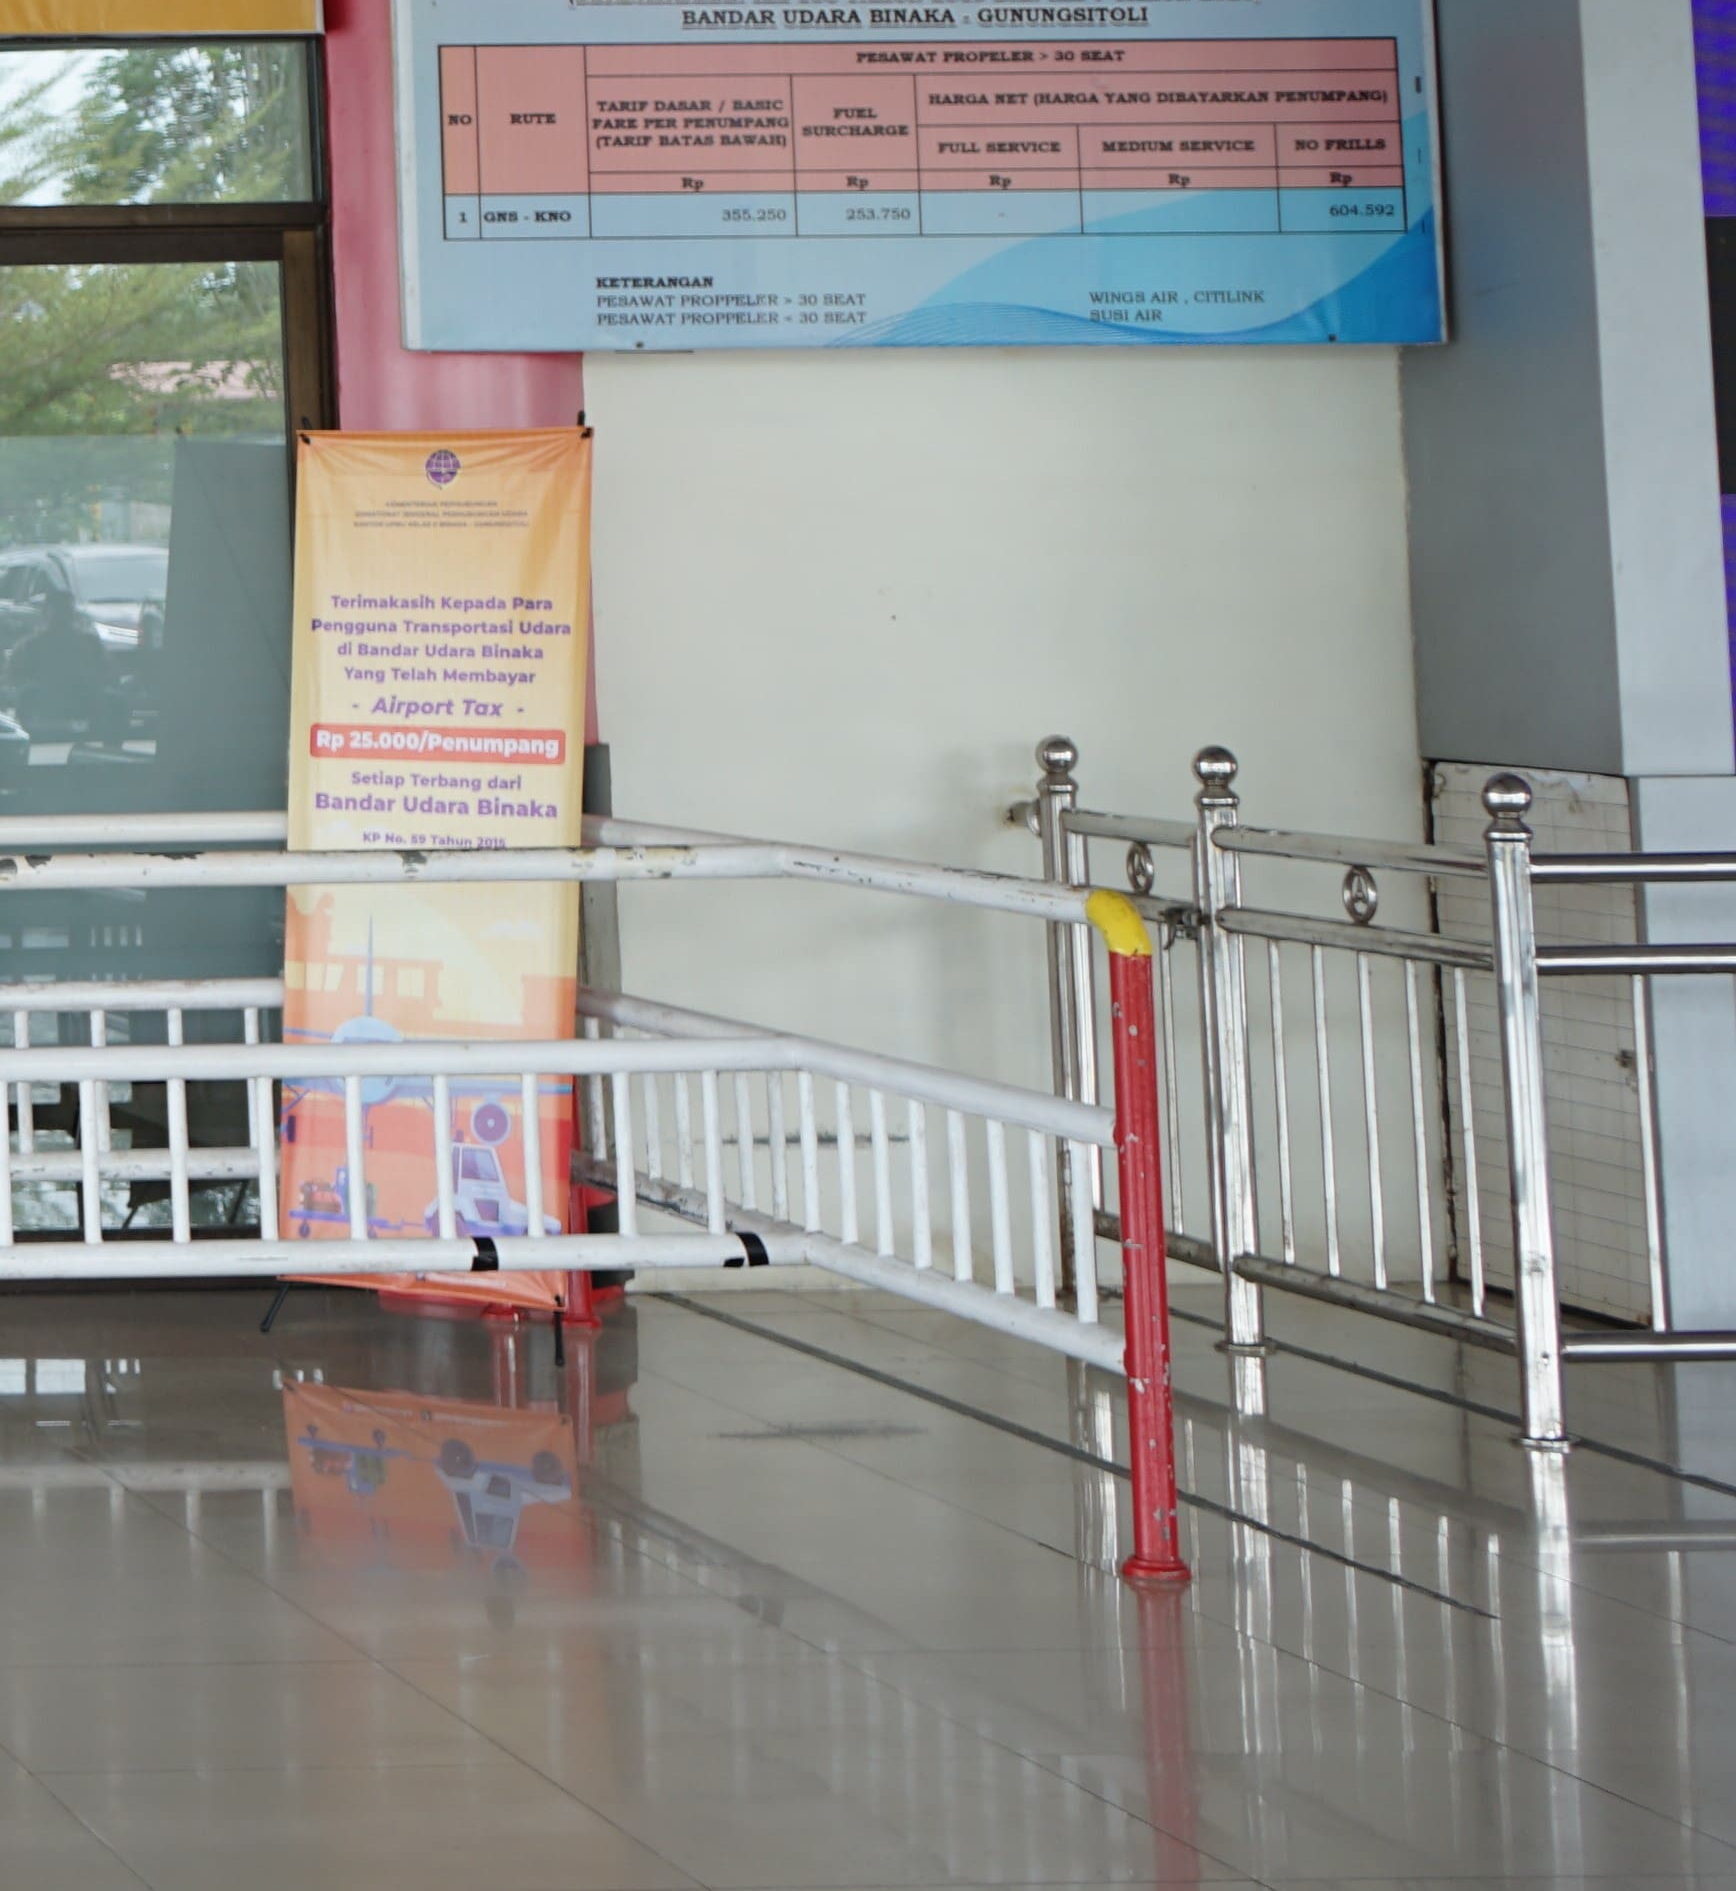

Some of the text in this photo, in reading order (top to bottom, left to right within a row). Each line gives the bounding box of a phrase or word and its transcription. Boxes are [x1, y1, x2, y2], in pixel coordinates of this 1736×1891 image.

[682, 7, 1148, 25] BANDAR UDARA BINAKA GUNUNGSITOLI
[722, 209, 786, 221] 355.250
[846, 208, 910, 221] 253.750
[1330, 204, 1394, 216] 604.592
[596, 277, 713, 289] KETERANGAN
[597, 294, 865, 307] PESAWAT PROPPELER 30 SEAT
[1089, 291, 1264, 304] WINGS AIR CITILINK
[597, 311, 866, 325] PESAWAT PROPPELER 30 SEAT
[1091, 309, 1162, 321] SUSI AIR
[332, 594, 552, 612] Terimakasih Kepada Para
[312, 619, 571, 636] Pengguna Transportasi Udara
[338, 642, 543, 659] di Bandar Udara Binaka
[344, 667, 535, 686] Yang Telah Membayar
[372, 696, 503, 718] Airport Tax
[317, 730, 559, 758] Rp 25.000/Penumpang
[352, 771, 522, 792] Setiap Terbang dari
[316, 792, 557, 818] Bandar Udara Binaka
[363, 832, 380, 844] KP
[385, 833, 406, 844] No.
[432, 834, 472, 848] Tahun
